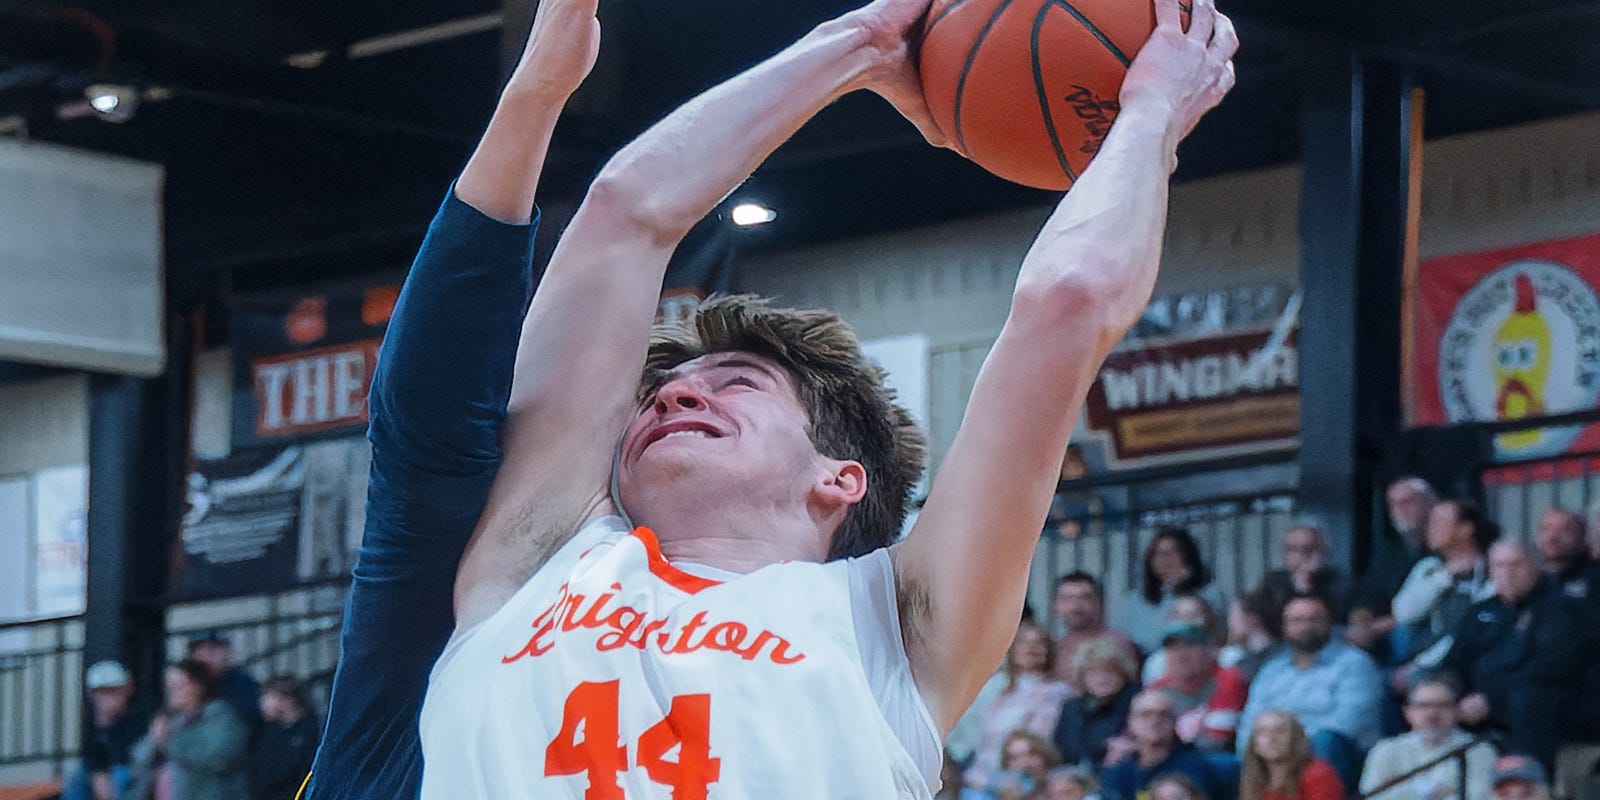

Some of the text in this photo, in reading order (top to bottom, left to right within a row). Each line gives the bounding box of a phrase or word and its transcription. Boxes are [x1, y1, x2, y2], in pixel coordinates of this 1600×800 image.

[255, 351, 365, 429] THE
[1100, 345, 1299, 410] WINGMA
[501, 580, 806, 665] Brigton
[544, 679, 721, 800] 44
